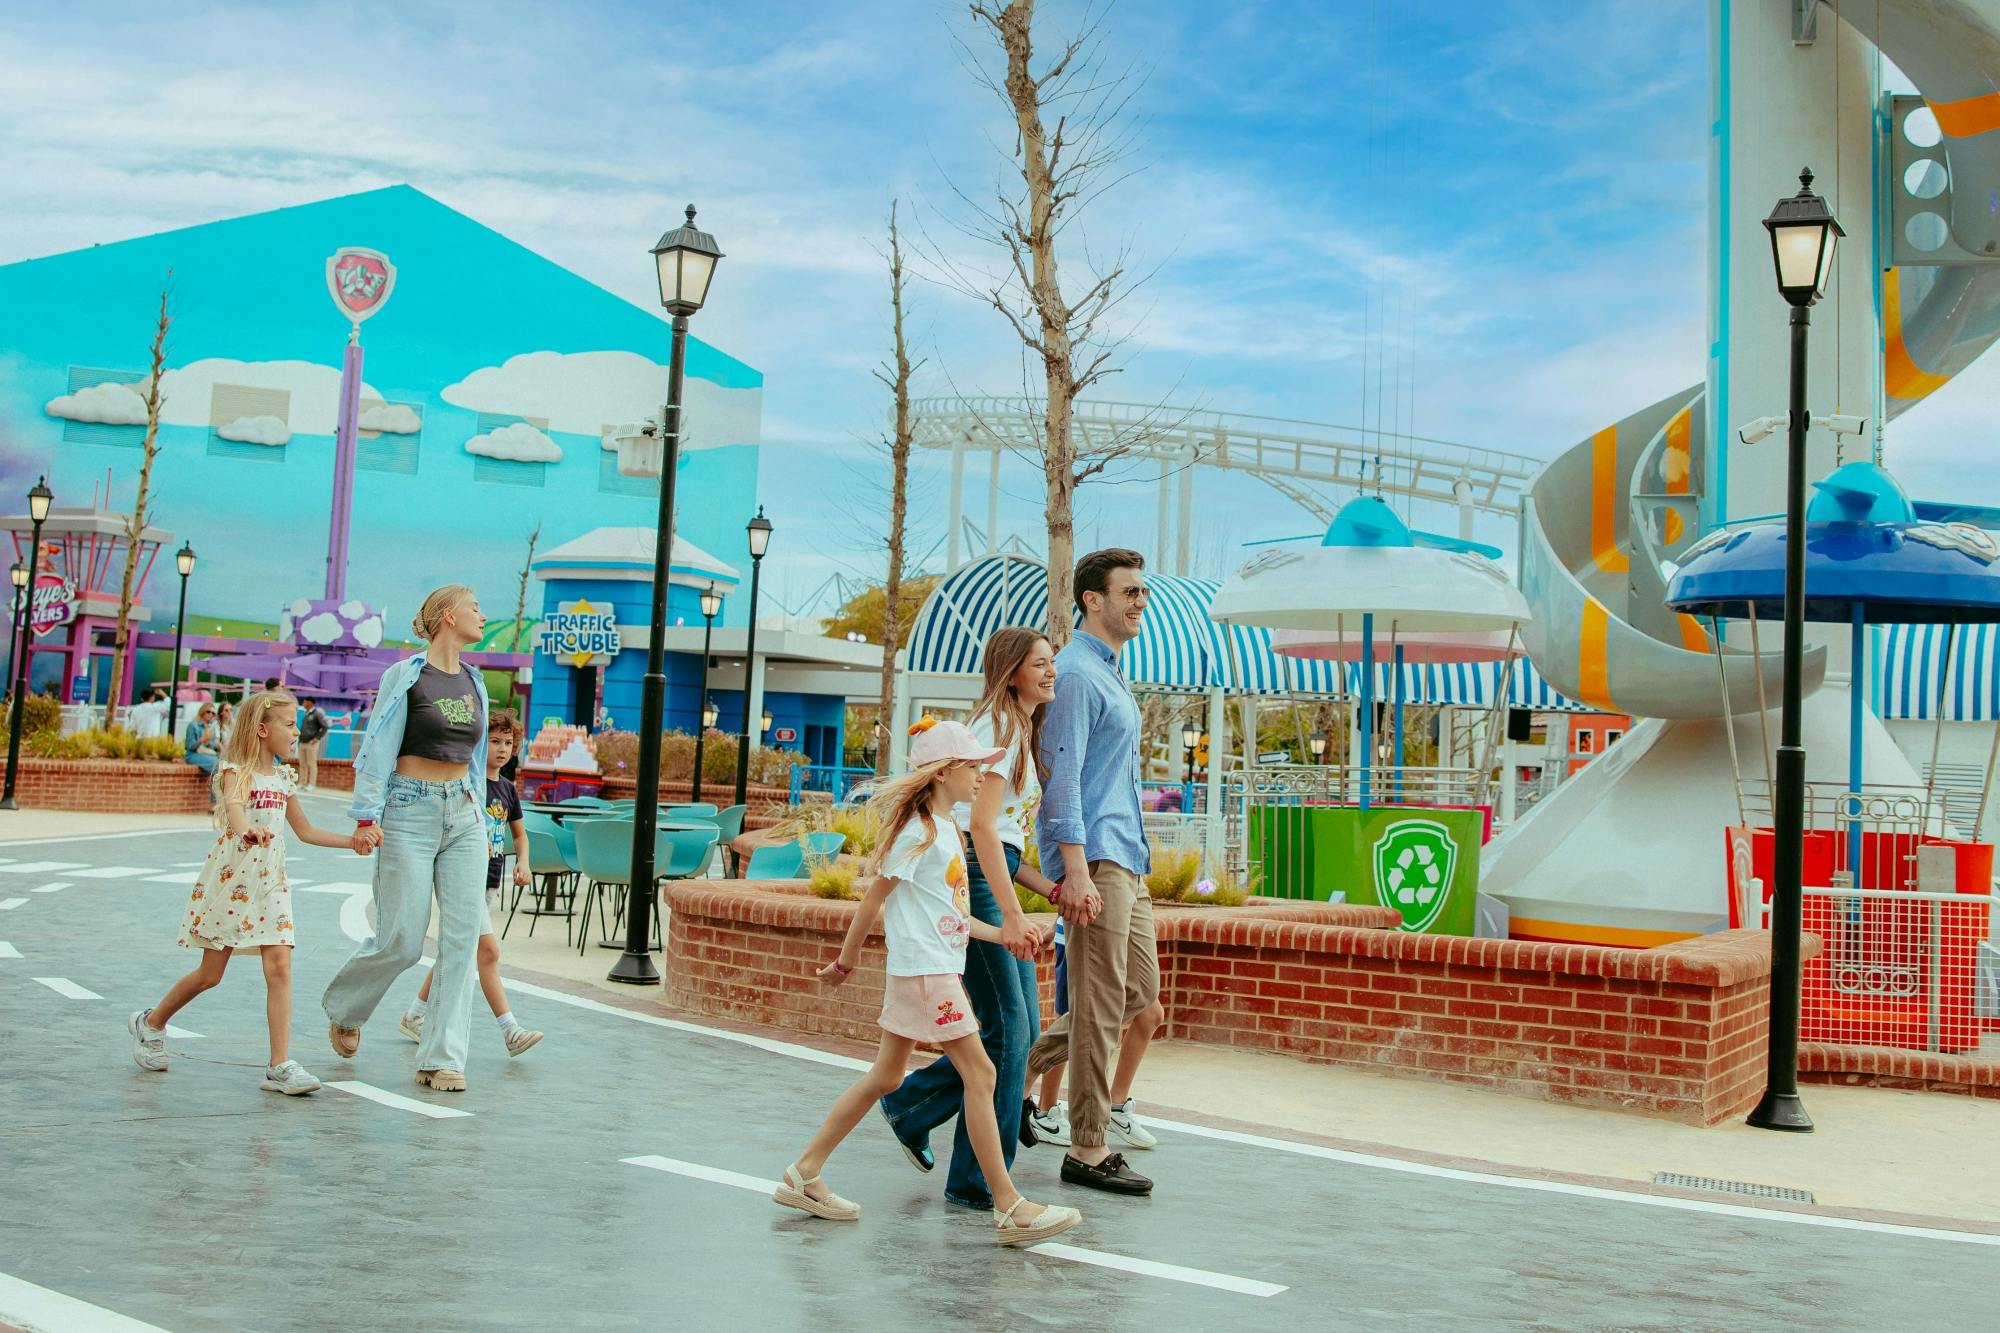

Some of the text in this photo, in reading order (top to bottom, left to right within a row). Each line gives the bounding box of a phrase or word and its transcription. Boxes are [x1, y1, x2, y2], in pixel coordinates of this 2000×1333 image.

[21, 605, 64, 626] YERS
[545, 613, 615, 632] TRAFFIC
[540, 632, 619, 654] TROUBLE
[1813, 841, 1823, 854] 3
